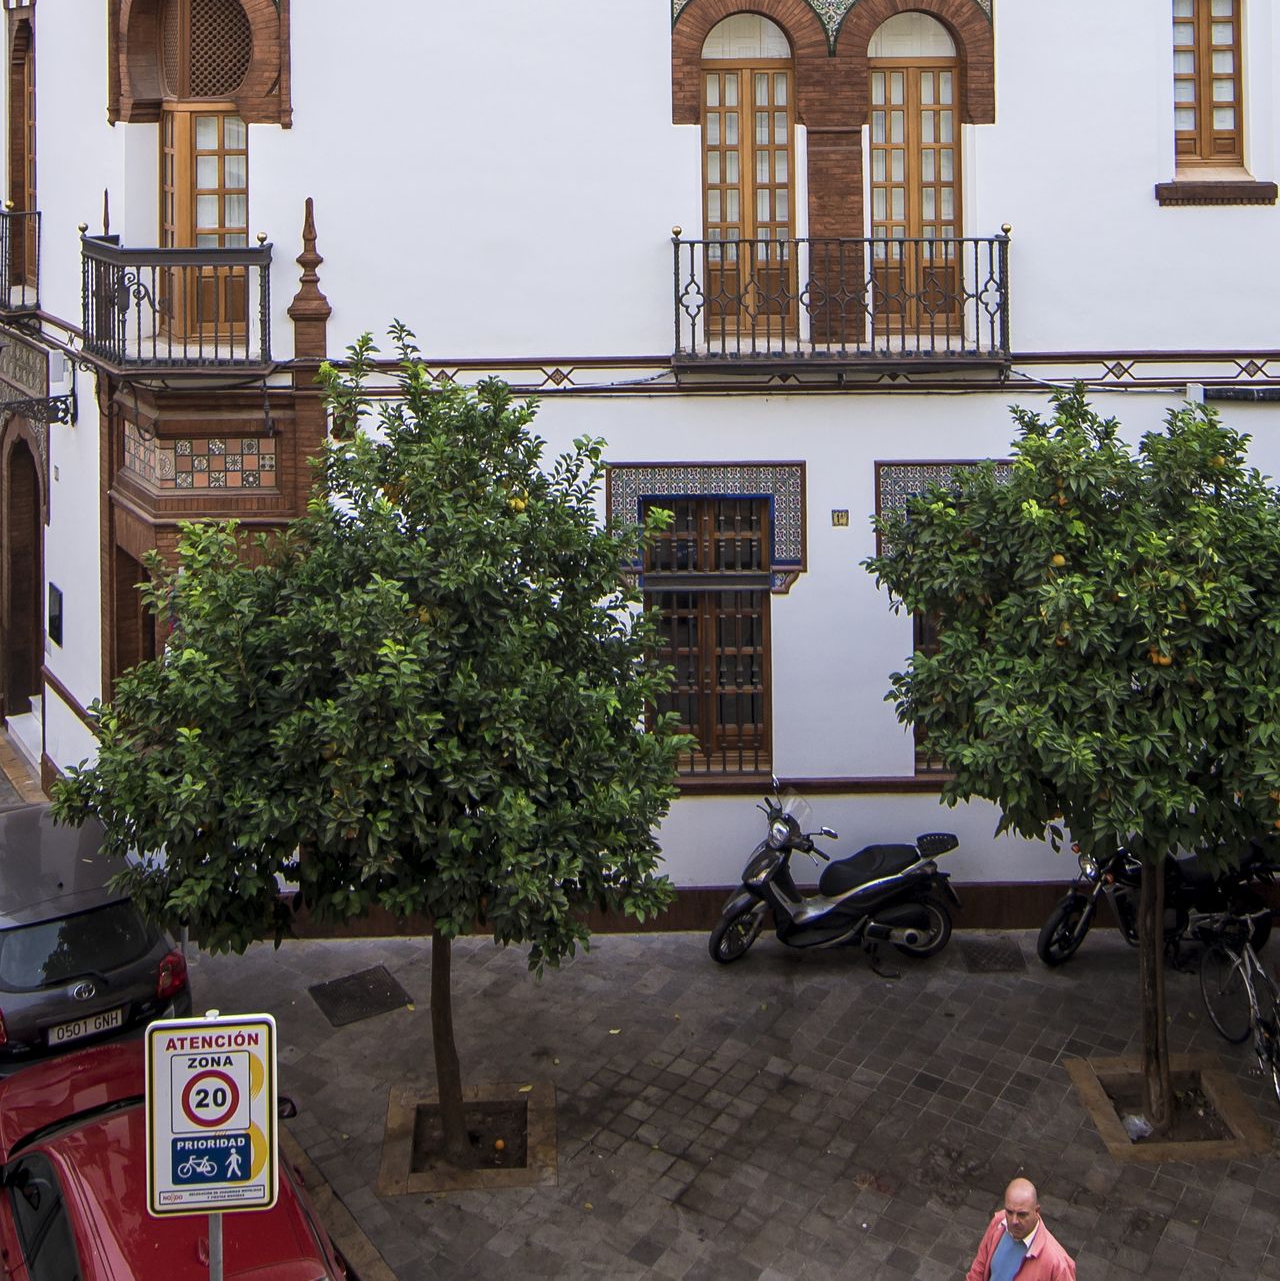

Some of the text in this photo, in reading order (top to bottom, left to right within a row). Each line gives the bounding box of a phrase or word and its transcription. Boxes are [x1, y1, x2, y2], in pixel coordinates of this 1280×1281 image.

[56, 1011, 119, 1040] 0501 GNH
[165, 1030, 259, 1051] ATENCIÓN
[187, 1055, 234, 1069] ZONA
[194, 1087, 228, 1109] 20
[176, 1137, 246, 1151] PRIORIDAD
